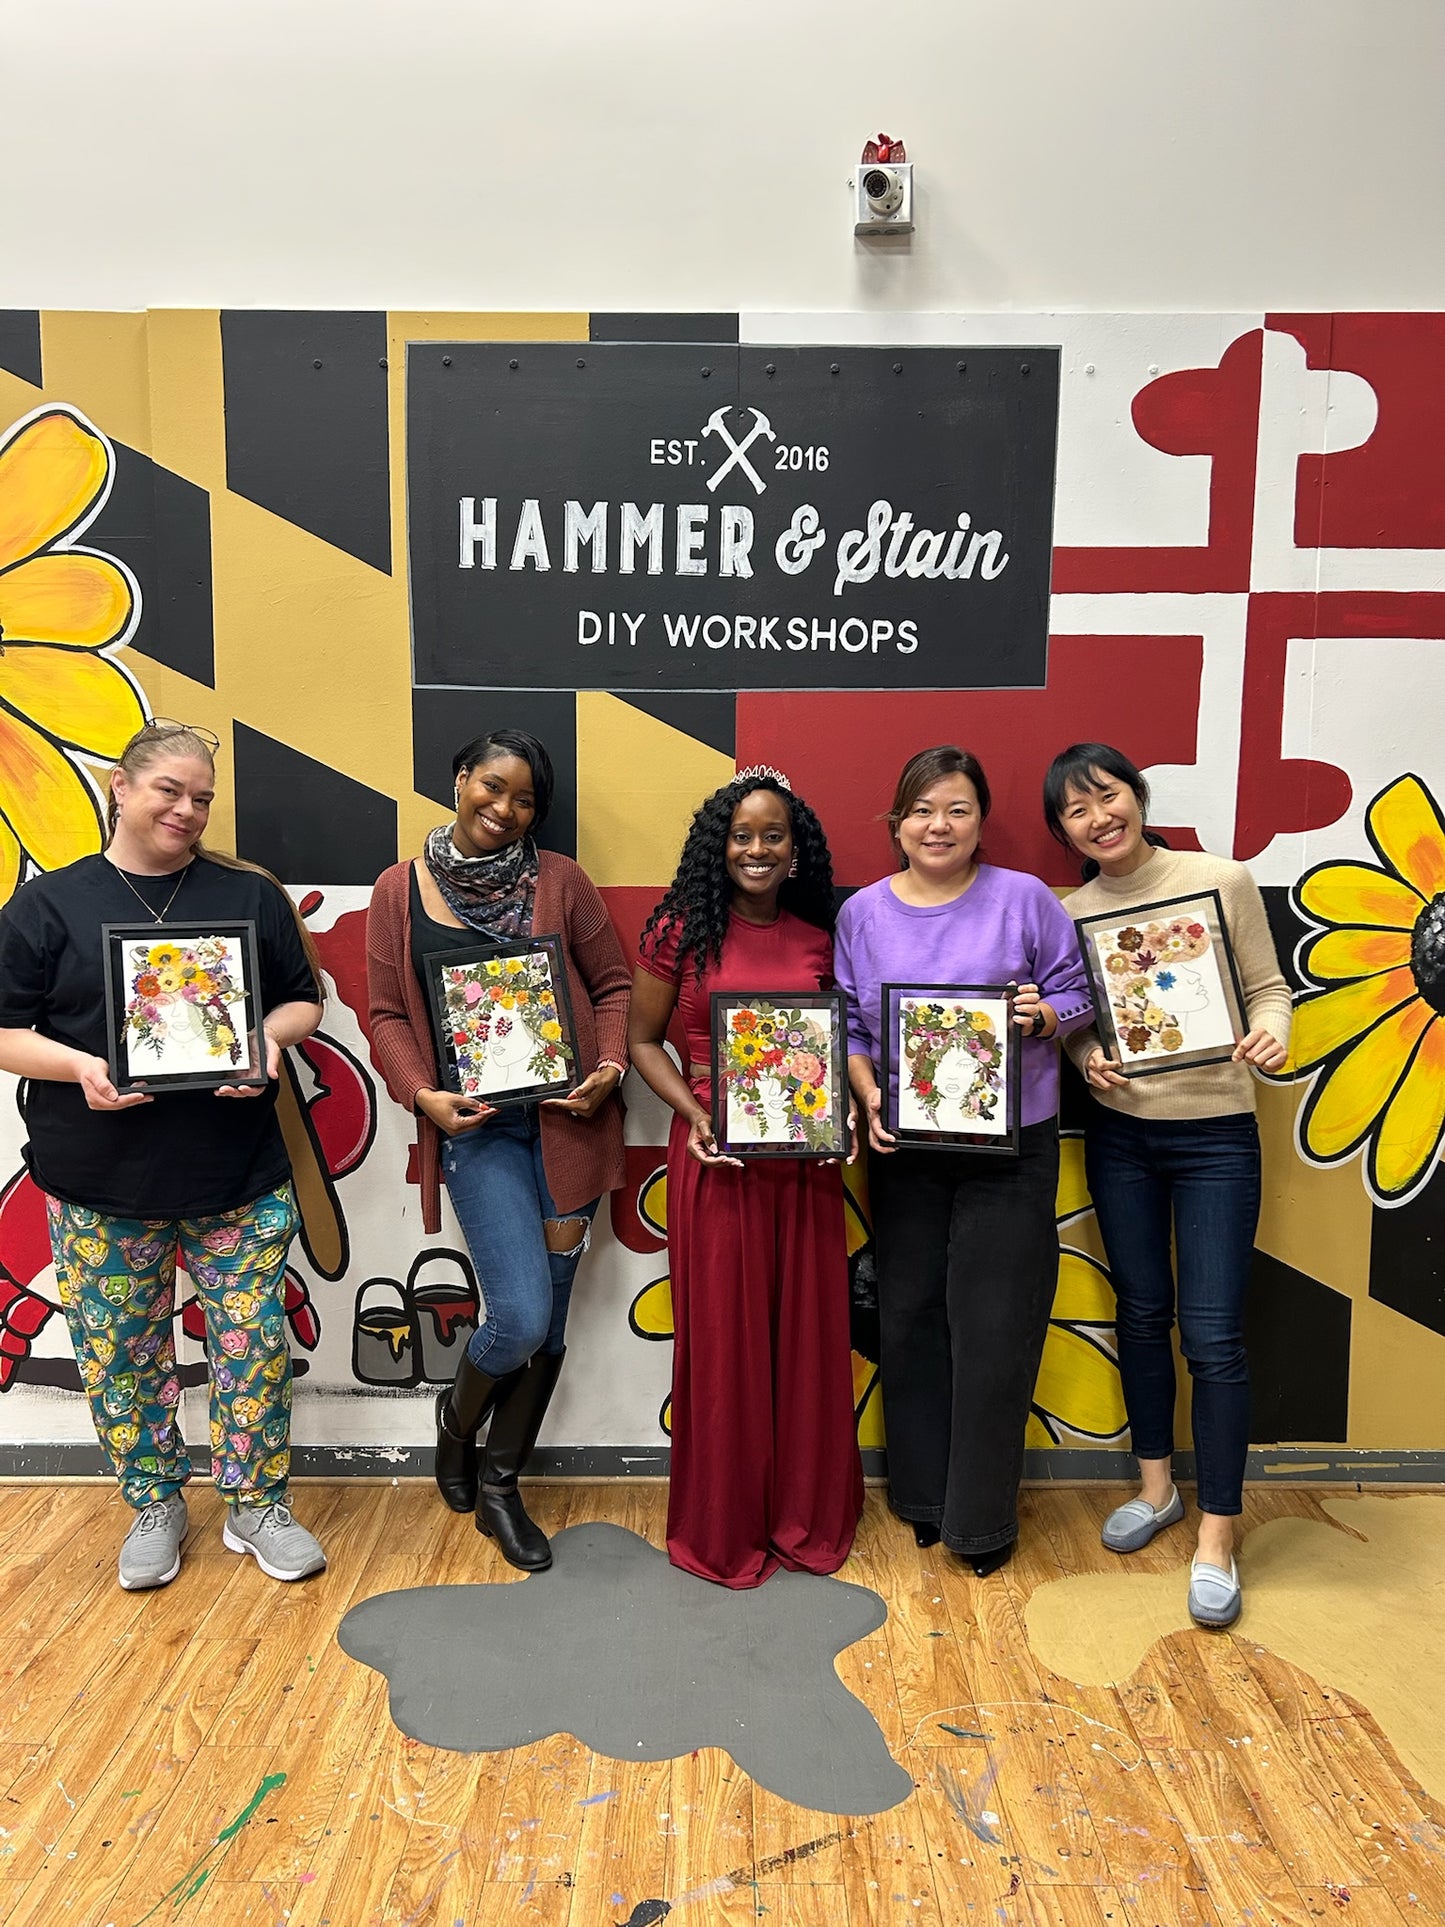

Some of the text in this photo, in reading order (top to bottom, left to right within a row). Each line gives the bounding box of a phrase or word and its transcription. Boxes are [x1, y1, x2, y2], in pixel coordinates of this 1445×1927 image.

[650, 439, 830, 472] EST. 2016
[458, 496, 1010, 596] HAMMER & Stain
[578, 610, 919, 654] DIY WORKSHOPS
